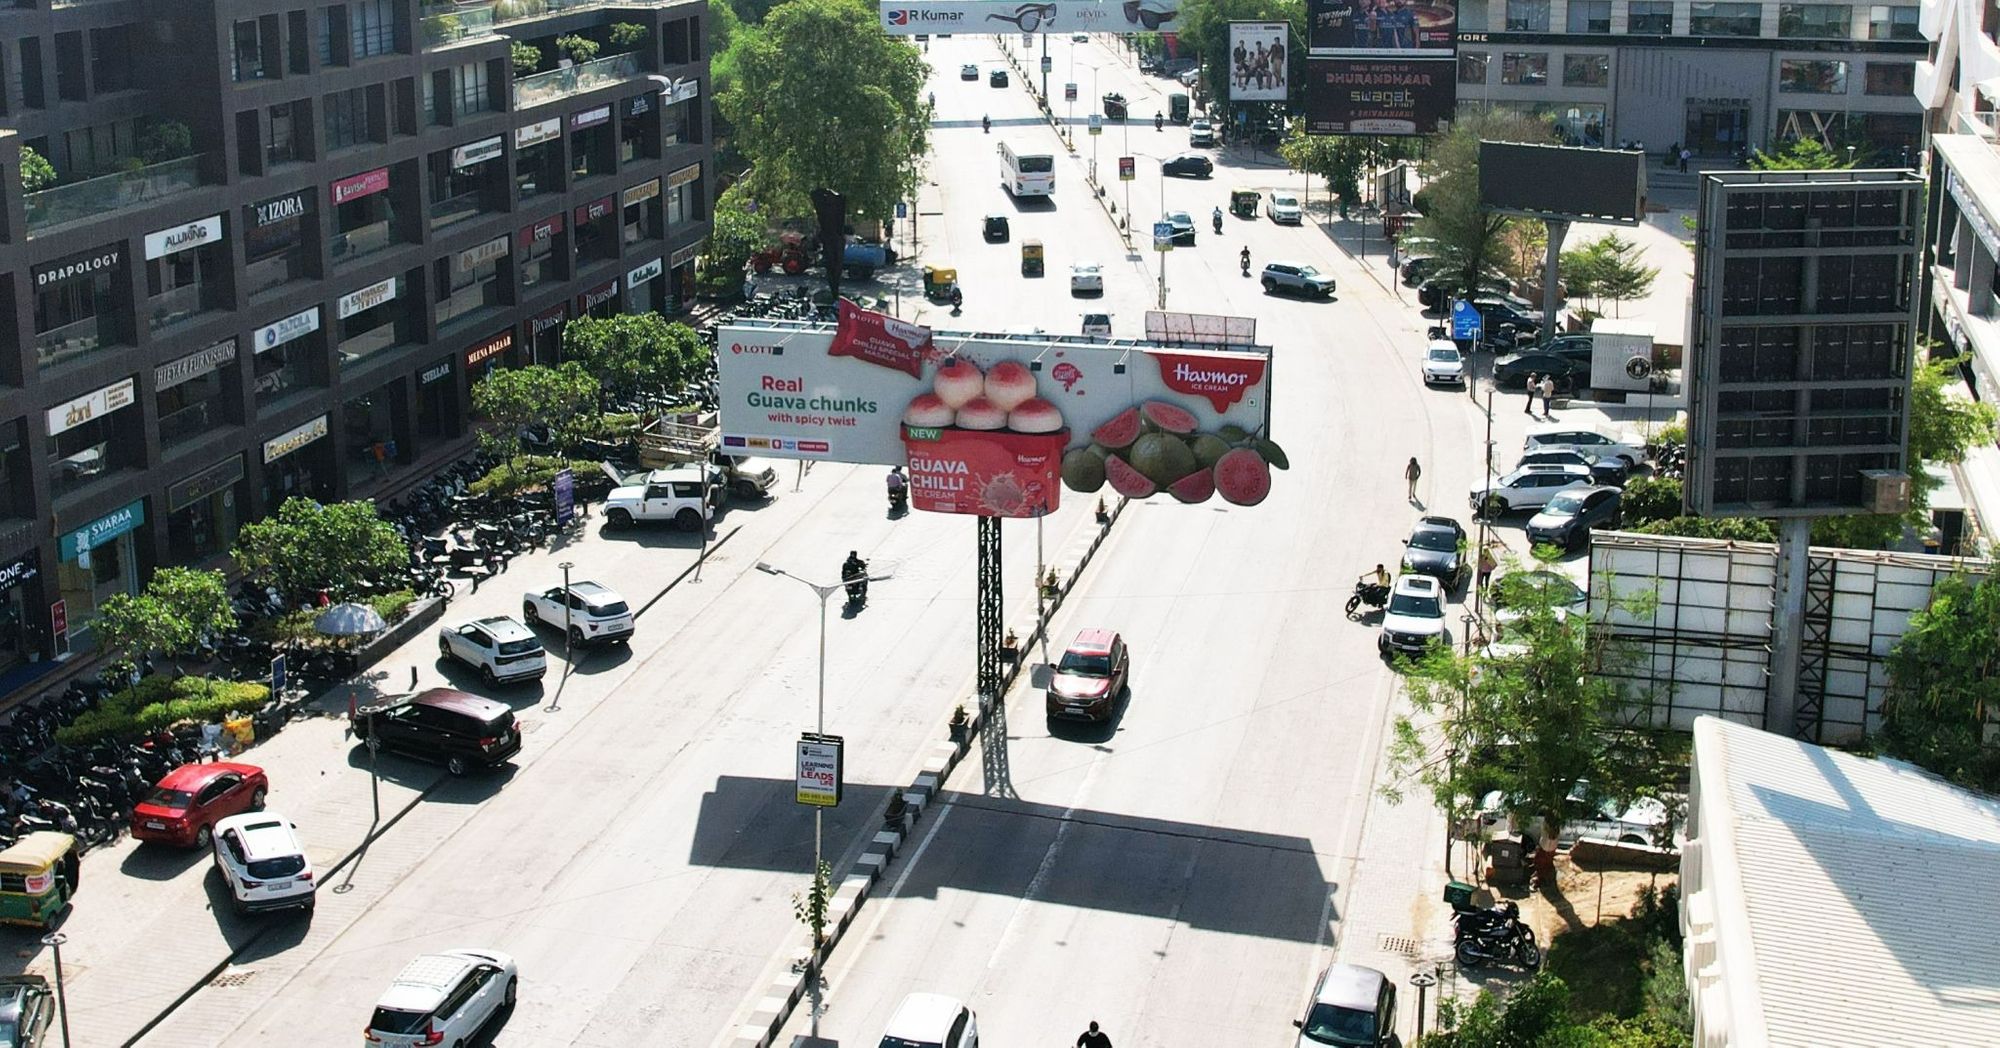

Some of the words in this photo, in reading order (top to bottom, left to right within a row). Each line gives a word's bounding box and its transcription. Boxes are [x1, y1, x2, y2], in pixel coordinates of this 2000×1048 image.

[909, 10, 919, 21] R
[921, 10, 964, 21] Kumar
[1350, 88, 1412, 107] swagat
[268, 195, 304, 220] IZORA
[38, 252, 119, 286] DRAPOLOGY
[488, 335, 512, 355] BAZAAR
[869, 336, 897, 349] GUAVA
[422, 363, 450, 385] STELLAR
[1173, 362, 1248, 385] Havmor
[762, 375, 803, 393] Real
[1203, 384, 1228, 392] CREAM
[747, 392, 806, 410] Guava
[810, 394, 877, 414] chunks
[768, 412, 793, 424] with
[795, 414, 825, 426] spicy
[827, 416, 856, 426] twist
[909, 428, 937, 439] NEW
[910, 458, 969, 475] GUAVA
[911, 475, 964, 491] CHILLI
[923, 490, 955, 498] CREAM
[91, 508, 132, 536] SVARAA
[801, 761, 834, 769] LEARNING
[801, 771, 834, 781] LEADS
